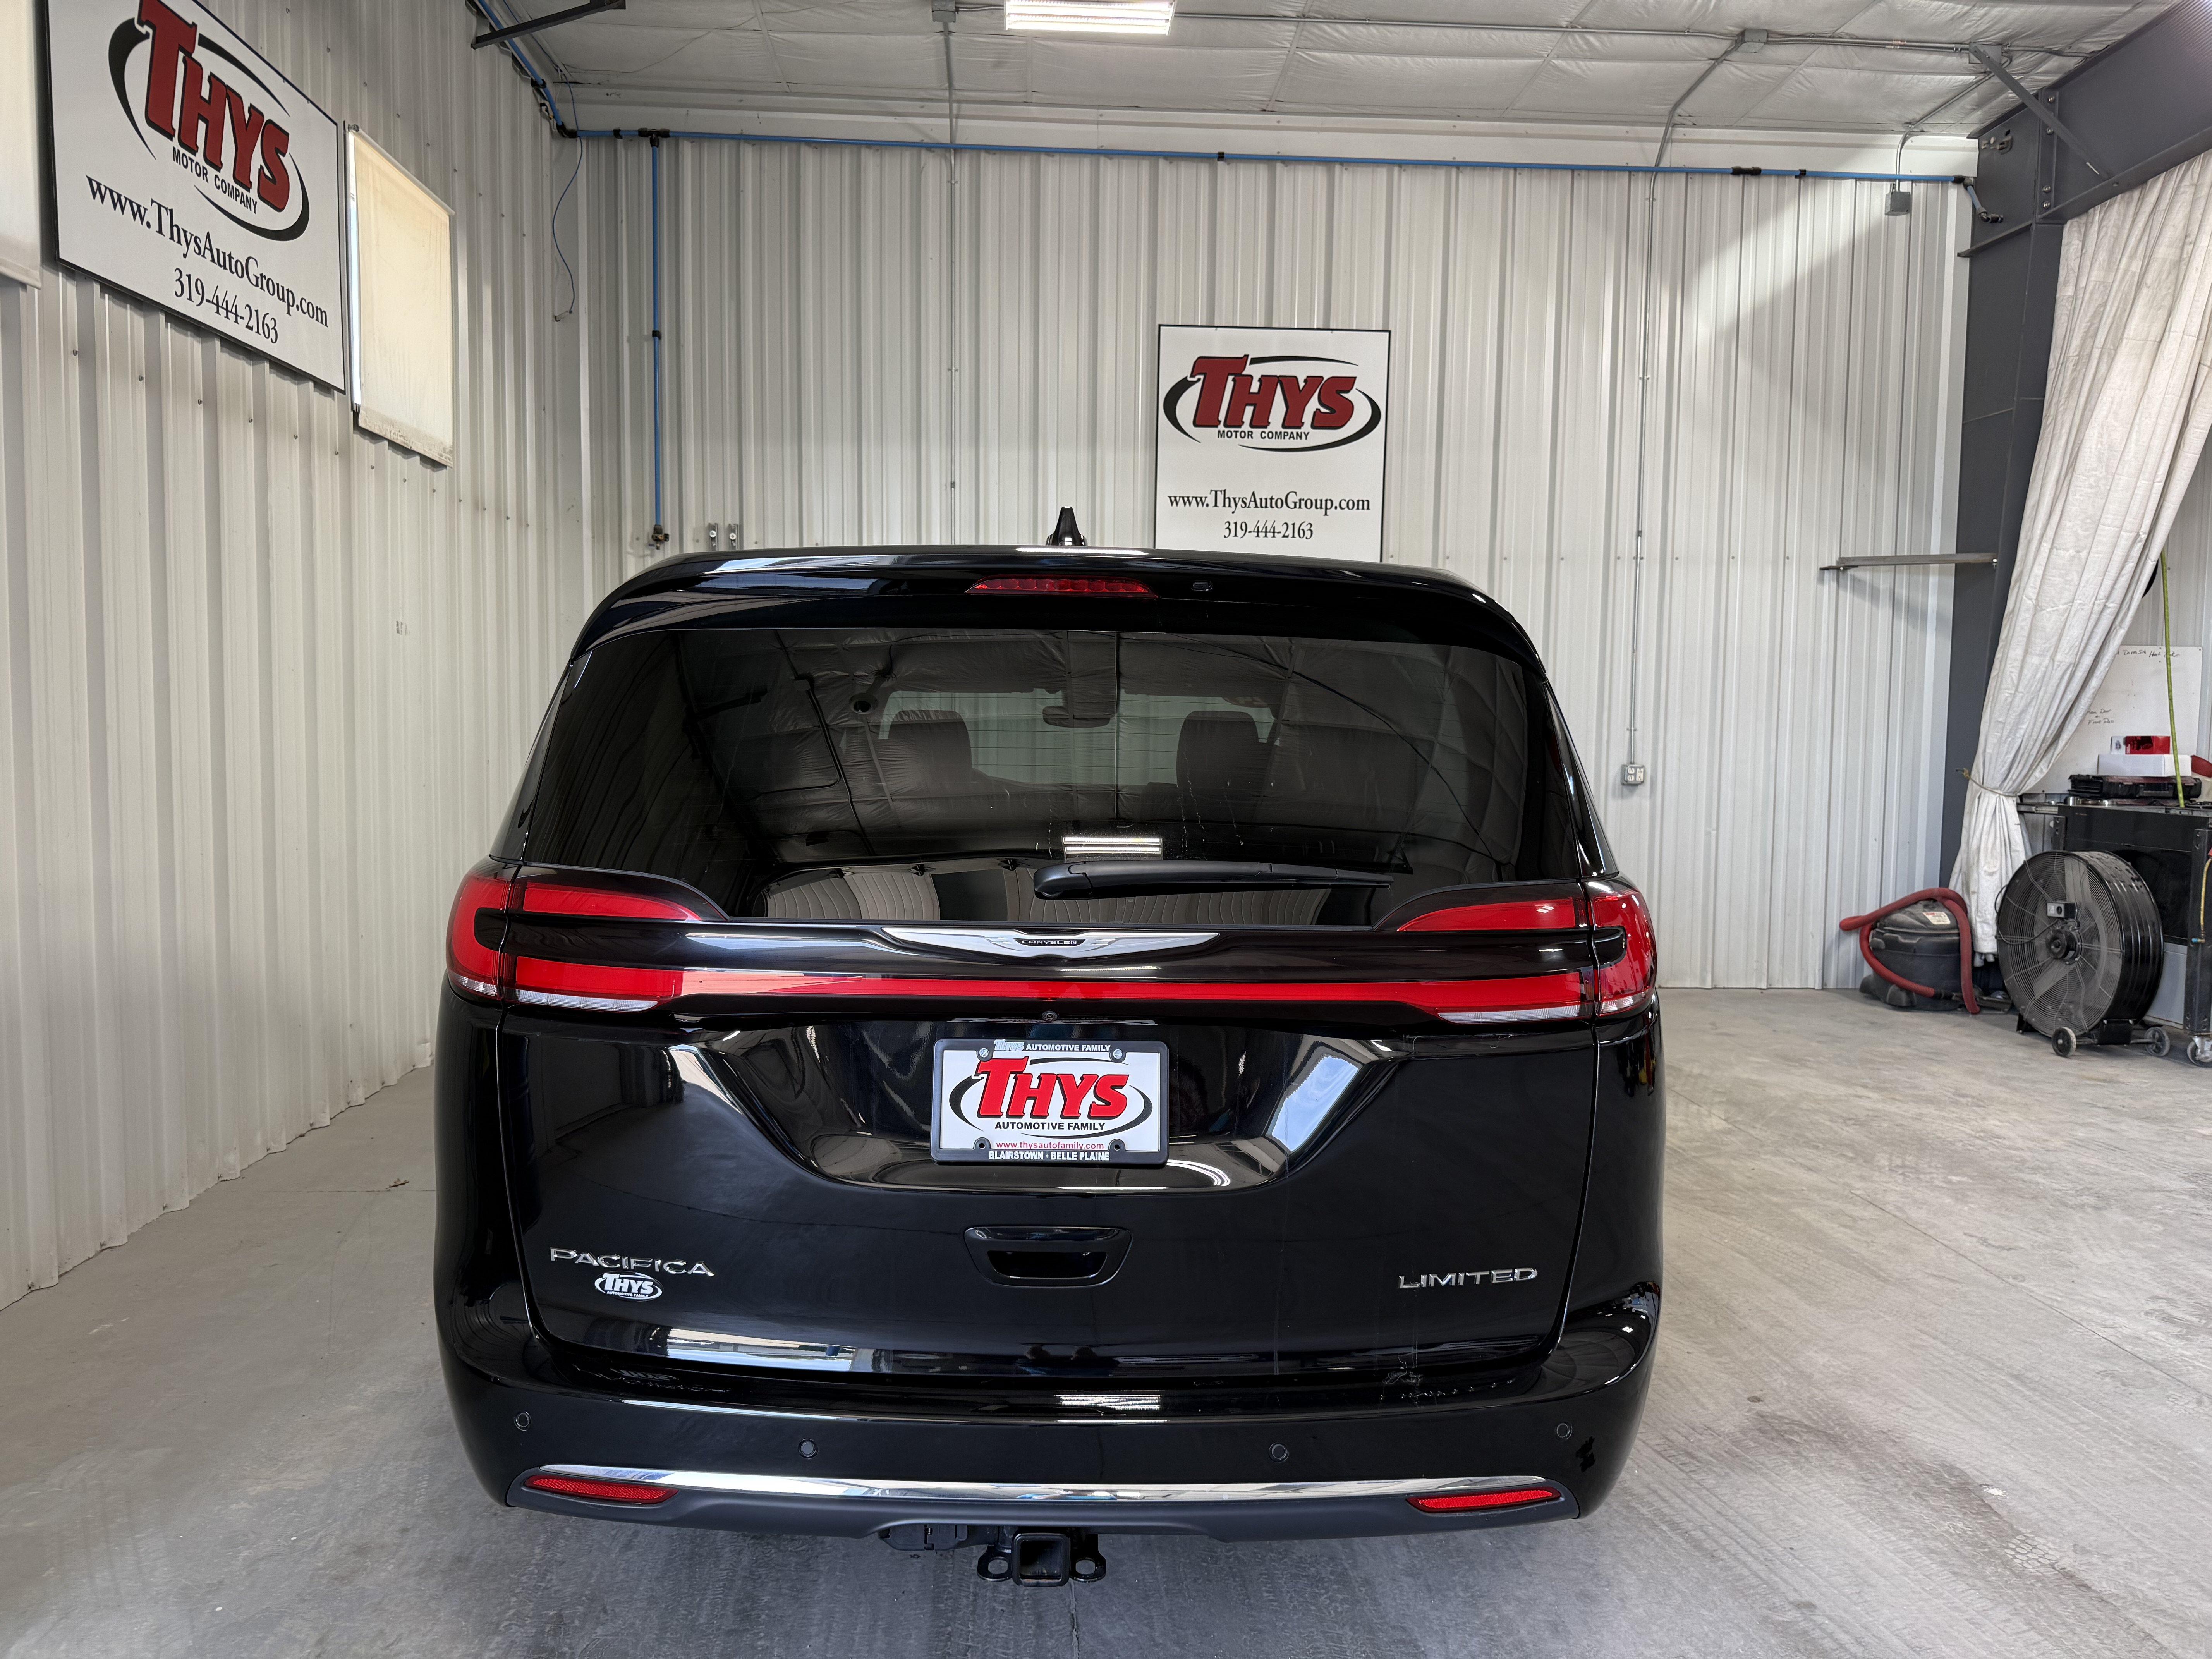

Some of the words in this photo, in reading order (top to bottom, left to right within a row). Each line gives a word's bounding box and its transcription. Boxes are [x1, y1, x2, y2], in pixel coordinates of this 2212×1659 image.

[136, 0, 290, 213] THYS
[172, 146, 208, 183] MOTOR
[214, 174, 258, 215] COMPANY
[86, 175, 329, 328] www.ThysAutoGroup.com
[174, 268, 279, 344] 319-444-2163
[1190, 354, 1357, 430] THYS
[1217, 429, 1254, 440] MOTOR
[1260, 430, 1310, 441] COMPANY
[1168, 489, 1371, 516] www.ThysAutoGroup.com
[1223, 520, 1314, 539] 319-444-2163
[976, 1056, 1130, 1120] THYS
[994, 1121, 1065, 1130] AUTOMOTIVE
[1067, 1122, 1106, 1130] FAMILY
[989, 1151, 1044, 1160] BLAIRSTOWN
[1050, 1152, 1077, 1160] BELLE
[1079, 1152, 1110, 1161] PLAINE
[996, 1141, 1104, 1150] www.thysautofamily.com
[550, 1246, 715, 1277] PACIFICA
[603, 1273, 654, 1295] THYS
[1398, 1267, 1538, 1289] LIMITED
